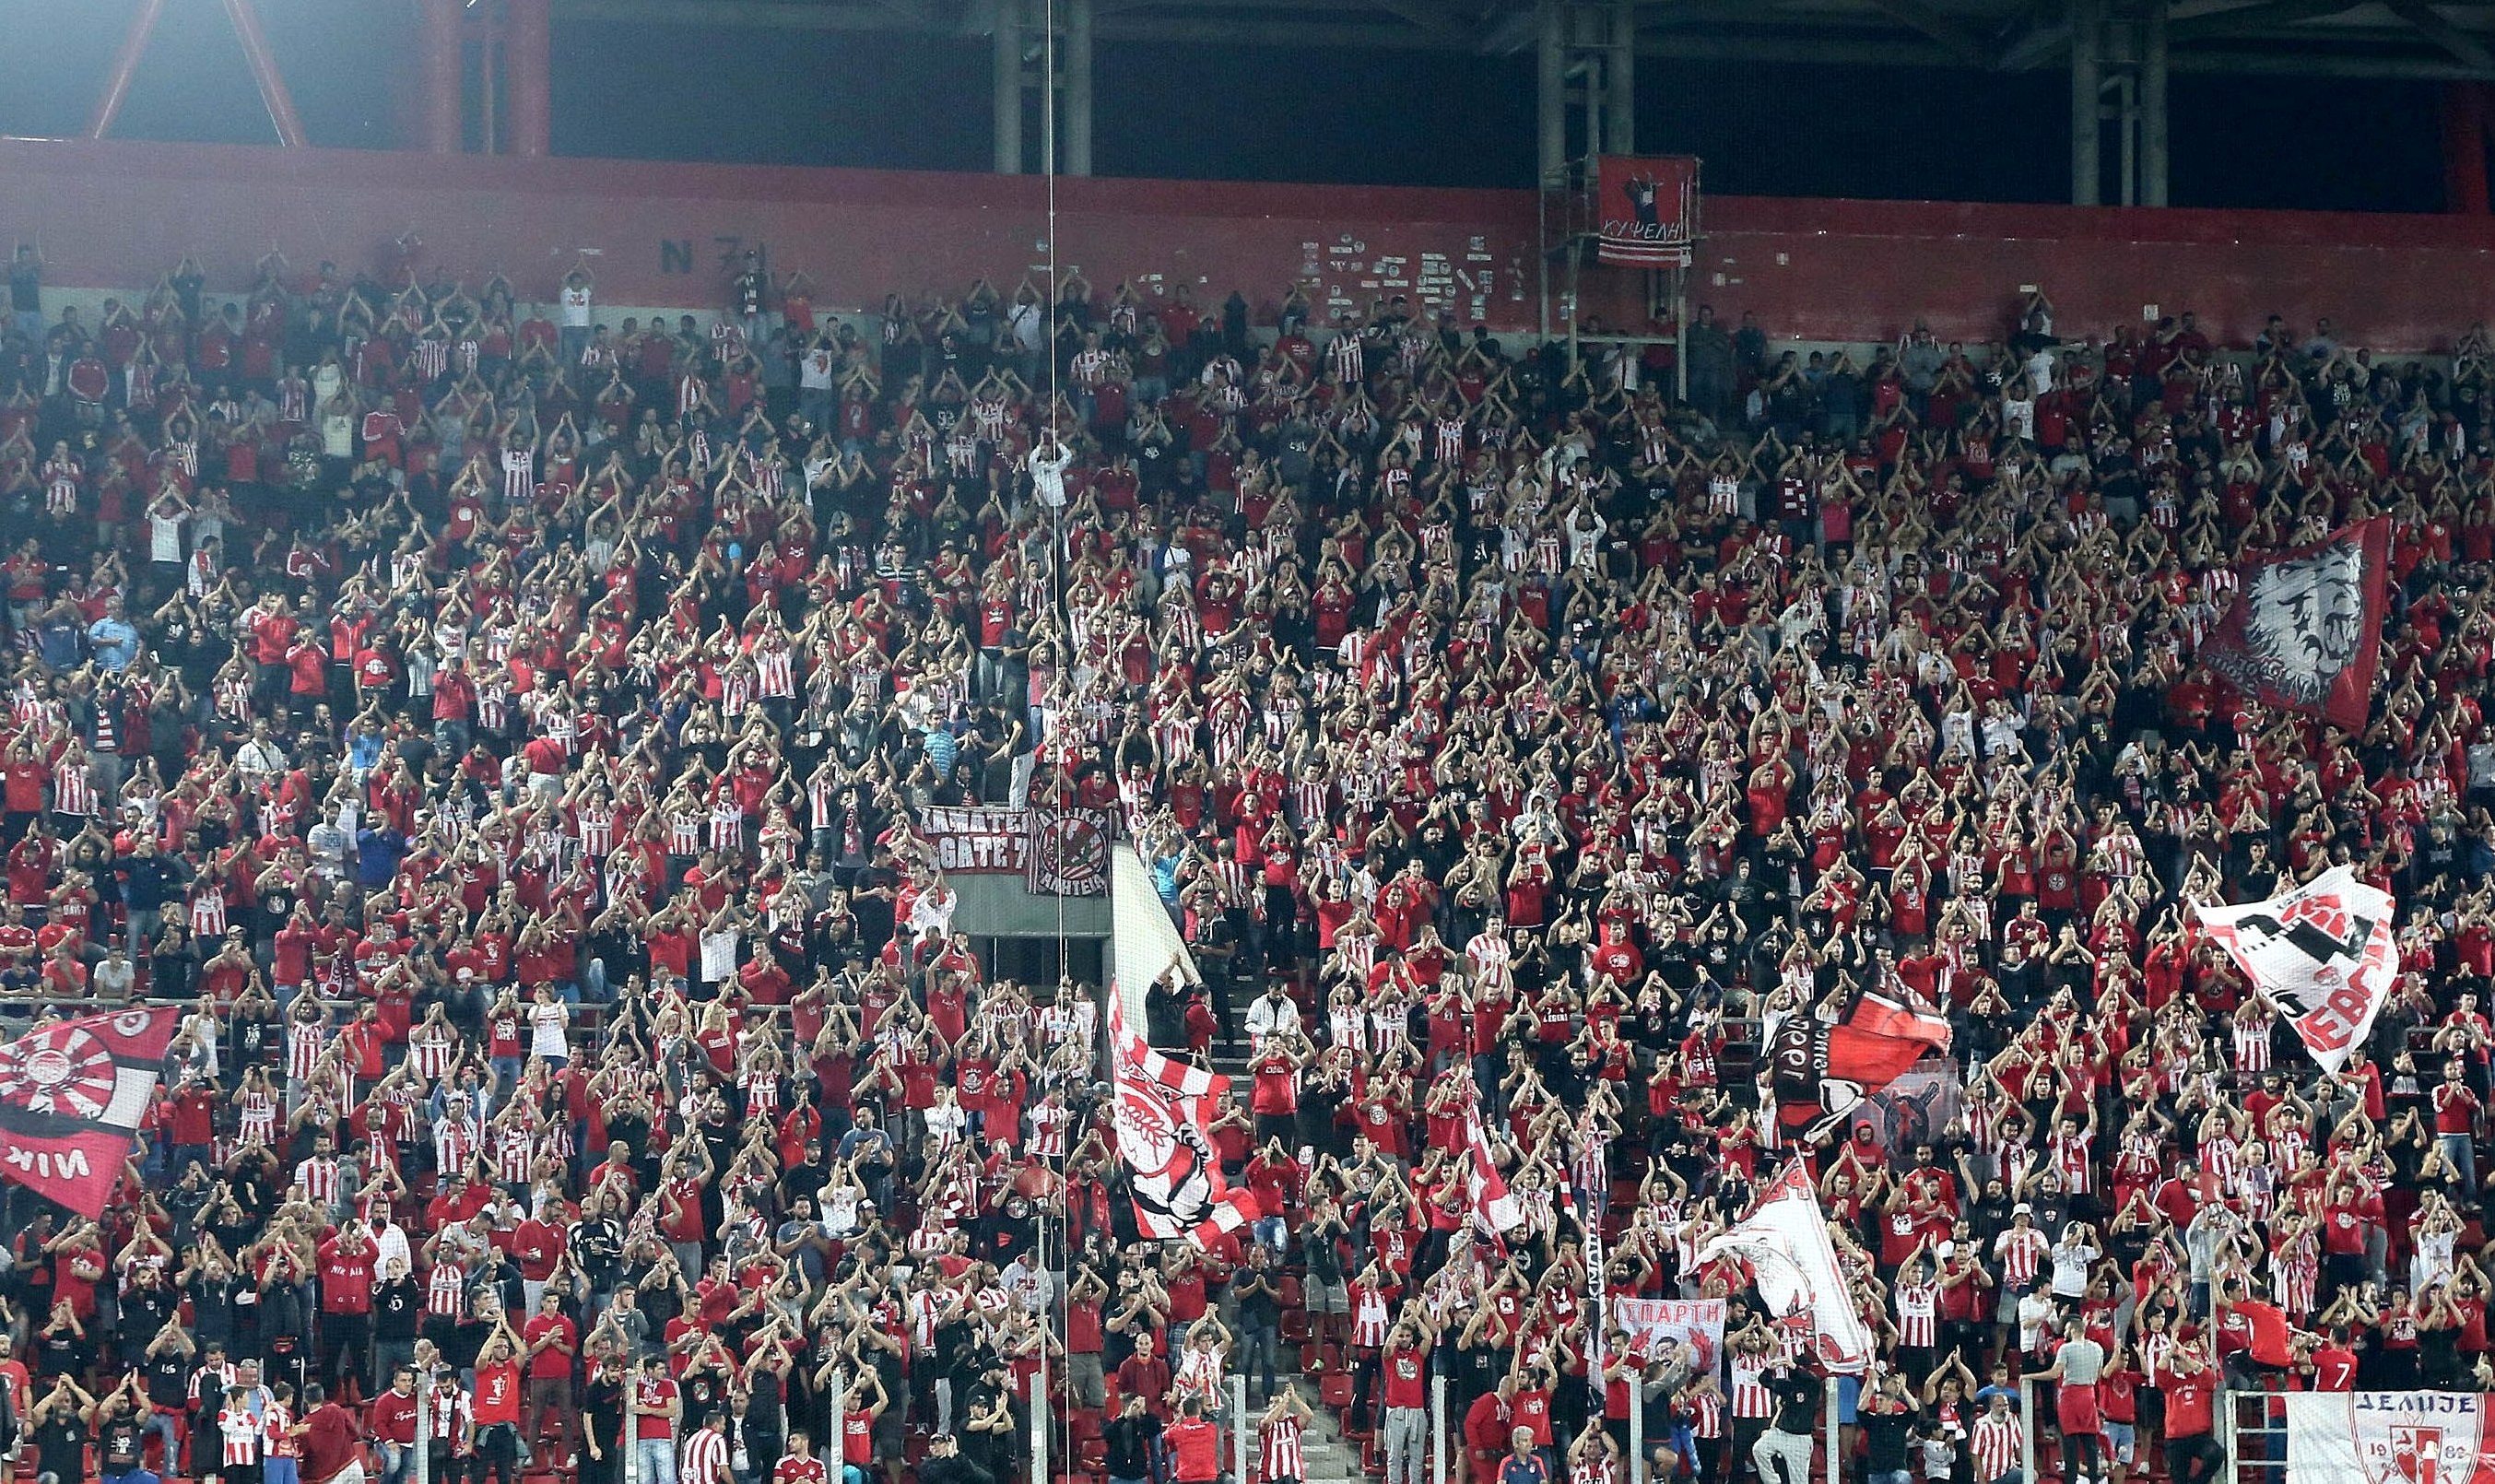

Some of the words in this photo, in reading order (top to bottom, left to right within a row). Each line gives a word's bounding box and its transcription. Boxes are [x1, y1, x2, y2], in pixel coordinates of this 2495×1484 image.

[938, 835, 1008, 870] GATE
[1014, 836, 1030, 870] 7
[1625, 1302, 1721, 1325] ΣΠΑΡΤΗ
[2334, 1362, 2351, 1389] 7
[2371, 1443, 2387, 1457] 19
